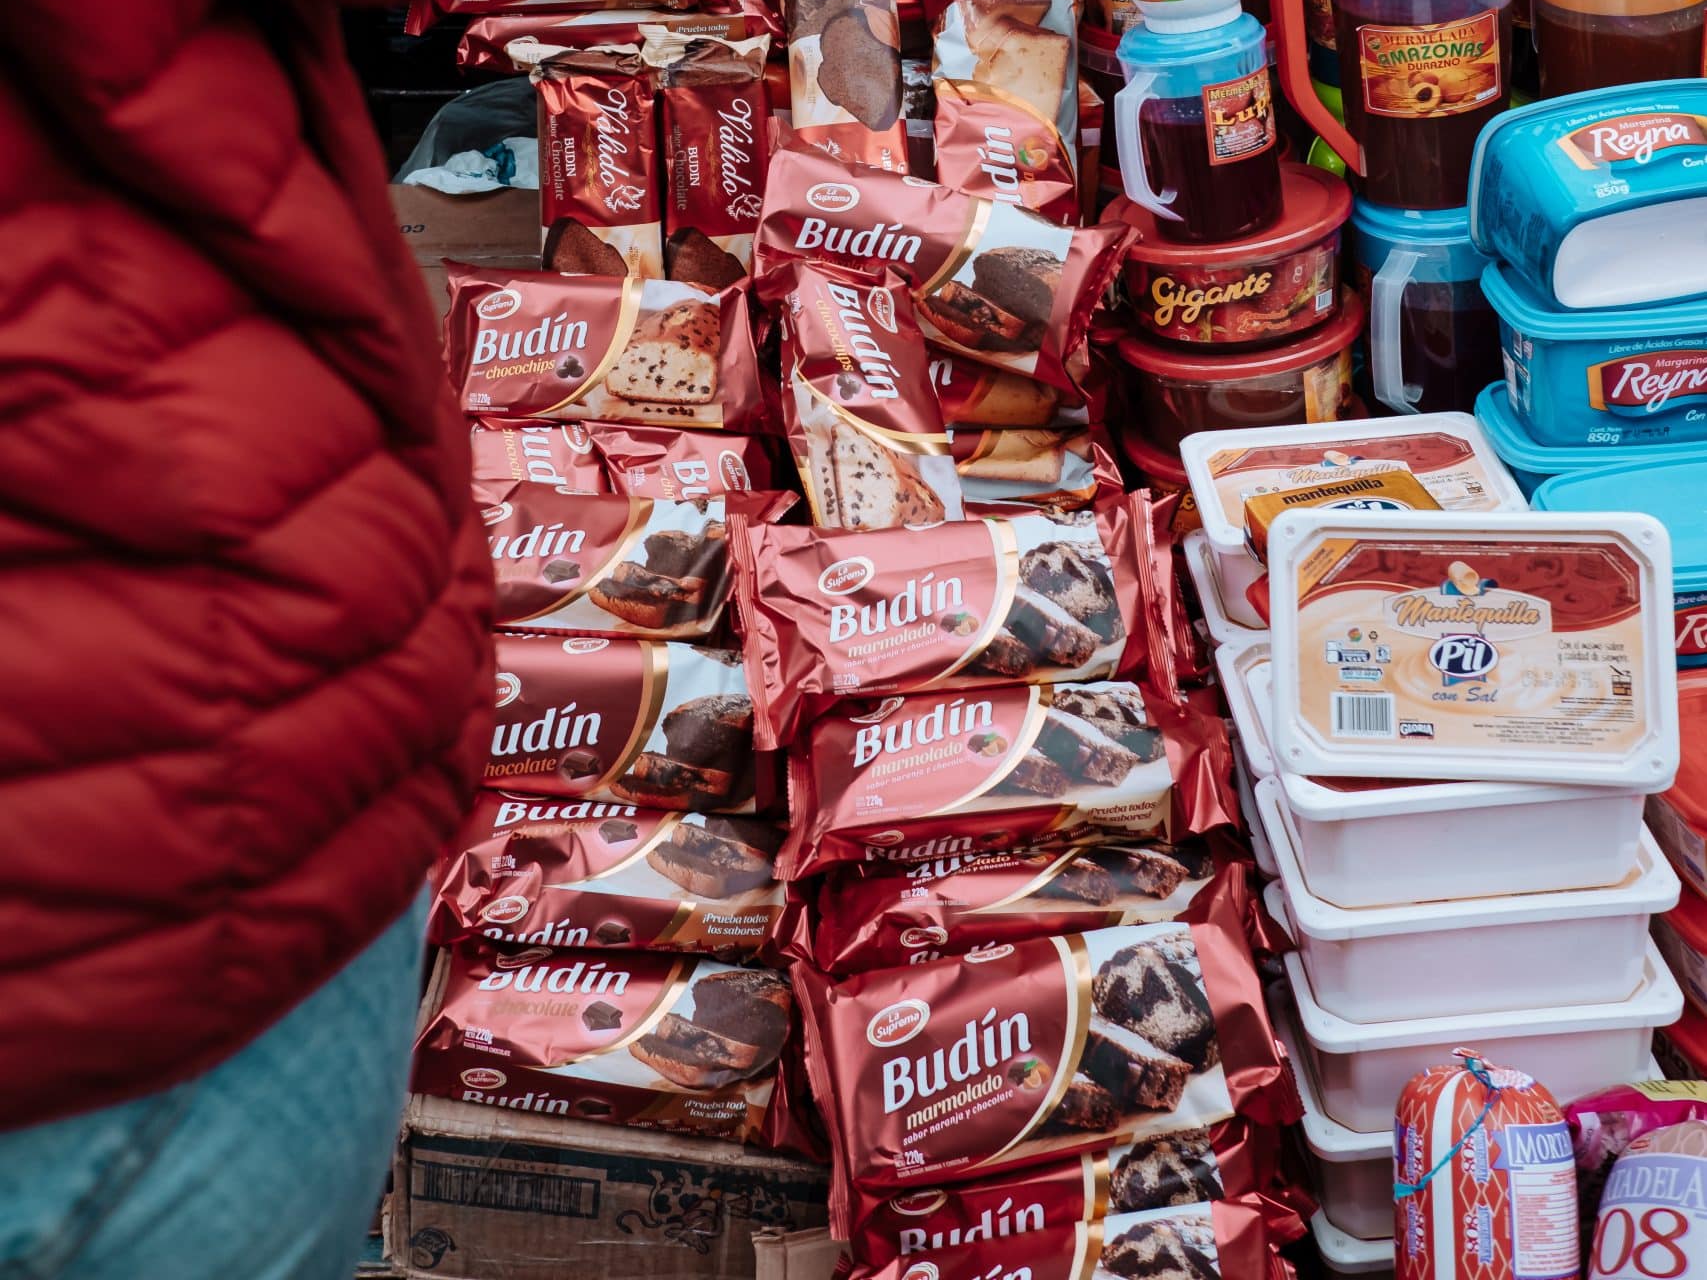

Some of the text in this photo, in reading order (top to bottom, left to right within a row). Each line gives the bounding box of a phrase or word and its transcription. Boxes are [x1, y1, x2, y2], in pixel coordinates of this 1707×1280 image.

[1384, 26, 1477, 45] MERMELADA
[1377, 41, 1485, 67] AMAZONAS
[1407, 57, 1461, 71] DURAZNO
[592, 87, 630, 189] Válido
[717, 97, 752, 196] Válido
[1589, 122, 1691, 164] Reyna
[551, 139, 565, 201] Chocolate
[563, 136, 577, 178] BUDIN
[687, 145, 700, 187] BUDIN
[1682, 157, 1704, 168] Con
[813, 192, 852, 204] Suprema
[827, 188, 837, 196] La
[795, 218, 923, 264] Budín
[1151, 271, 1273, 327] Gigante
[472, 312, 588, 367] Budín
[827, 280, 900, 400] Budín
[1609, 343, 1629, 355] Libre
[1630, 342, 1644, 352] de
[1674, 336, 1704, 348] Grasos
[485, 357, 556, 381] chocochips
[1282, 477, 1385, 505] mantequilla
[825, 570, 867, 589] Suprema
[837, 566, 848, 577] La
[829, 571, 964, 643] Budín
[1392, 595, 1540, 634] Mantequilla
[847, 622, 936, 659] marmolado
[1438, 638, 1487, 673] Pil
[1432, 686, 1499, 703] con Sal
[853, 697, 994, 768] Budín
[870, 742, 964, 778] marmolado
[702, 913, 769, 925] ¡Prueba todos
[708, 925, 765, 937] los sabores!
[876, 1013, 921, 1037] Suprema
[889, 1011, 900, 1023] La
[476, 1029, 494, 1045] 220g
[883, 1007, 1032, 1114] Budín
[902, 1127, 928, 1146] sabor
[929, 1113, 964, 1137] naranja
[972, 1088, 1014, 1116] chocolate
[905, 1073, 1003, 1130] marmolado
[904, 1150, 925, 1168] 220g
